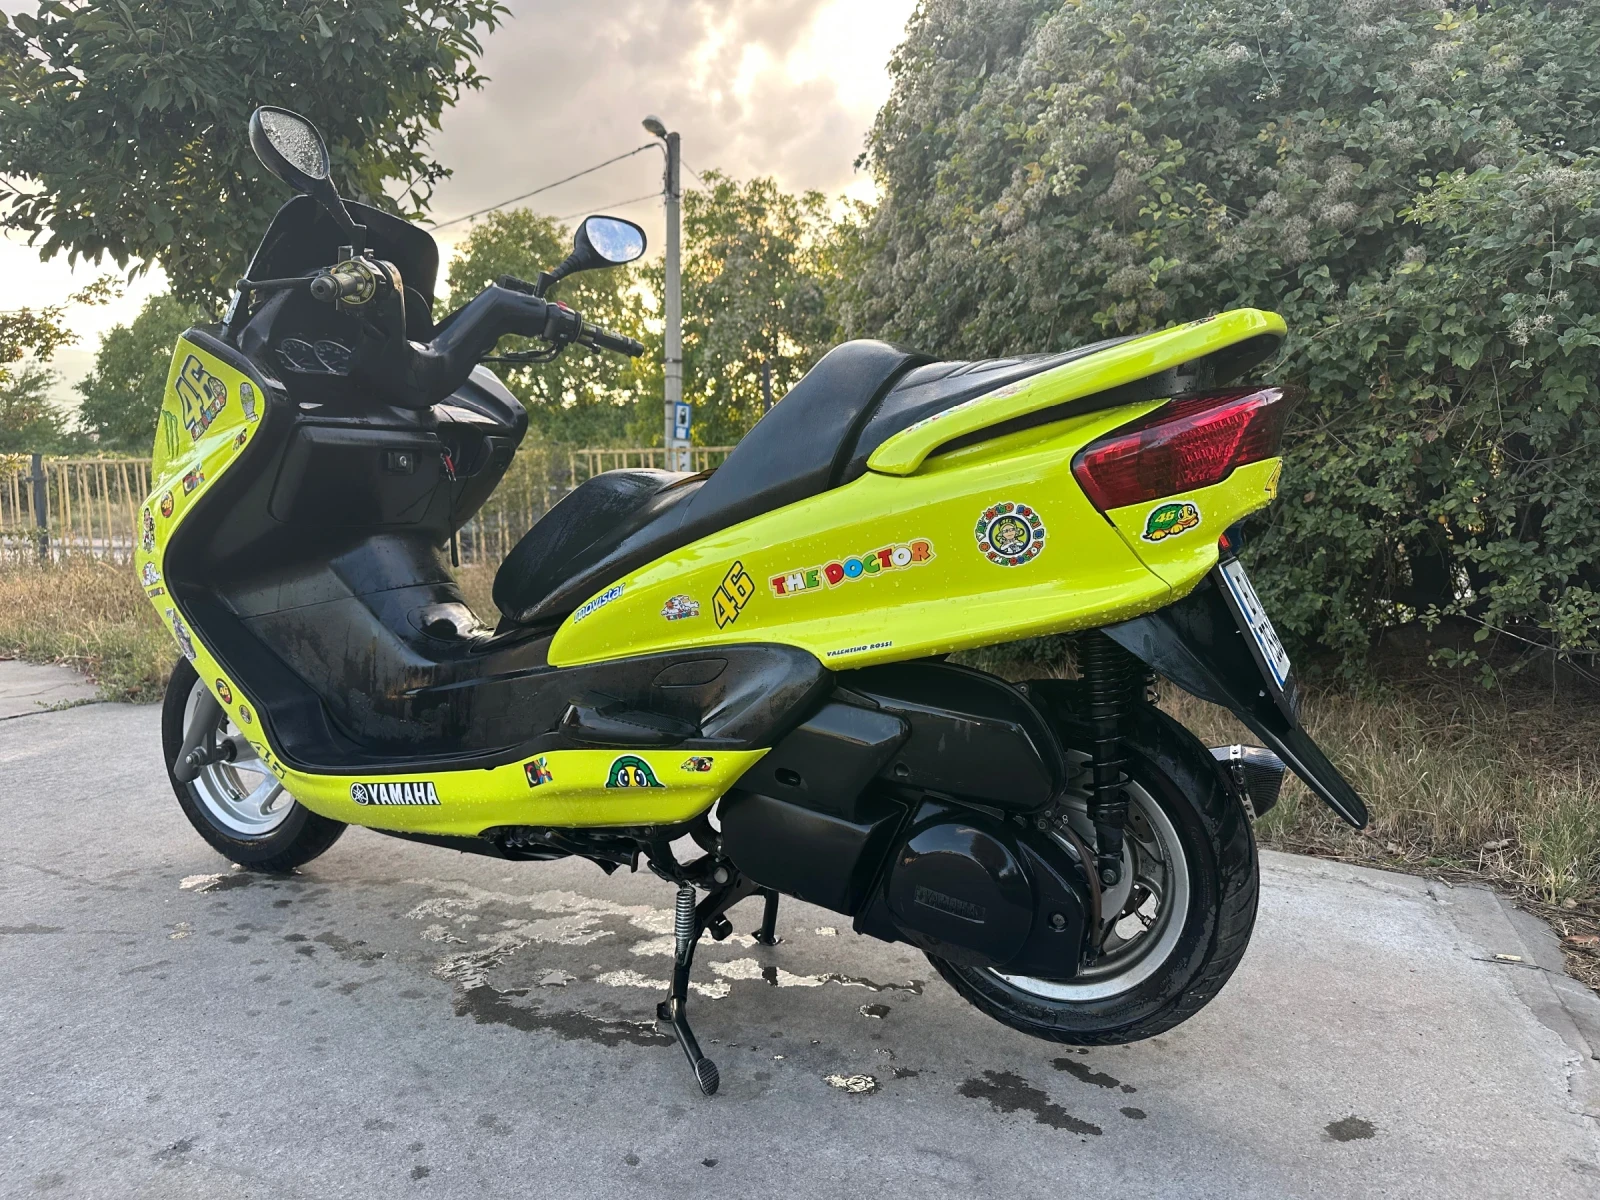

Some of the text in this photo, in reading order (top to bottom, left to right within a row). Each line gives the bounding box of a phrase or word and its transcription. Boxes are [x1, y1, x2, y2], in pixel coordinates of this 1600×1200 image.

[175, 354, 216, 431] 46
[1154, 510, 1176, 522] 46
[771, 541, 932, 595] THE DOCTOR
[574, 583, 626, 624] movistar
[712, 560, 755, 630] 46
[826, 640, 893, 657] VALENTINO ROSSI
[219, 685, 229, 696] 46
[367, 782, 440, 805] YAMAHA
